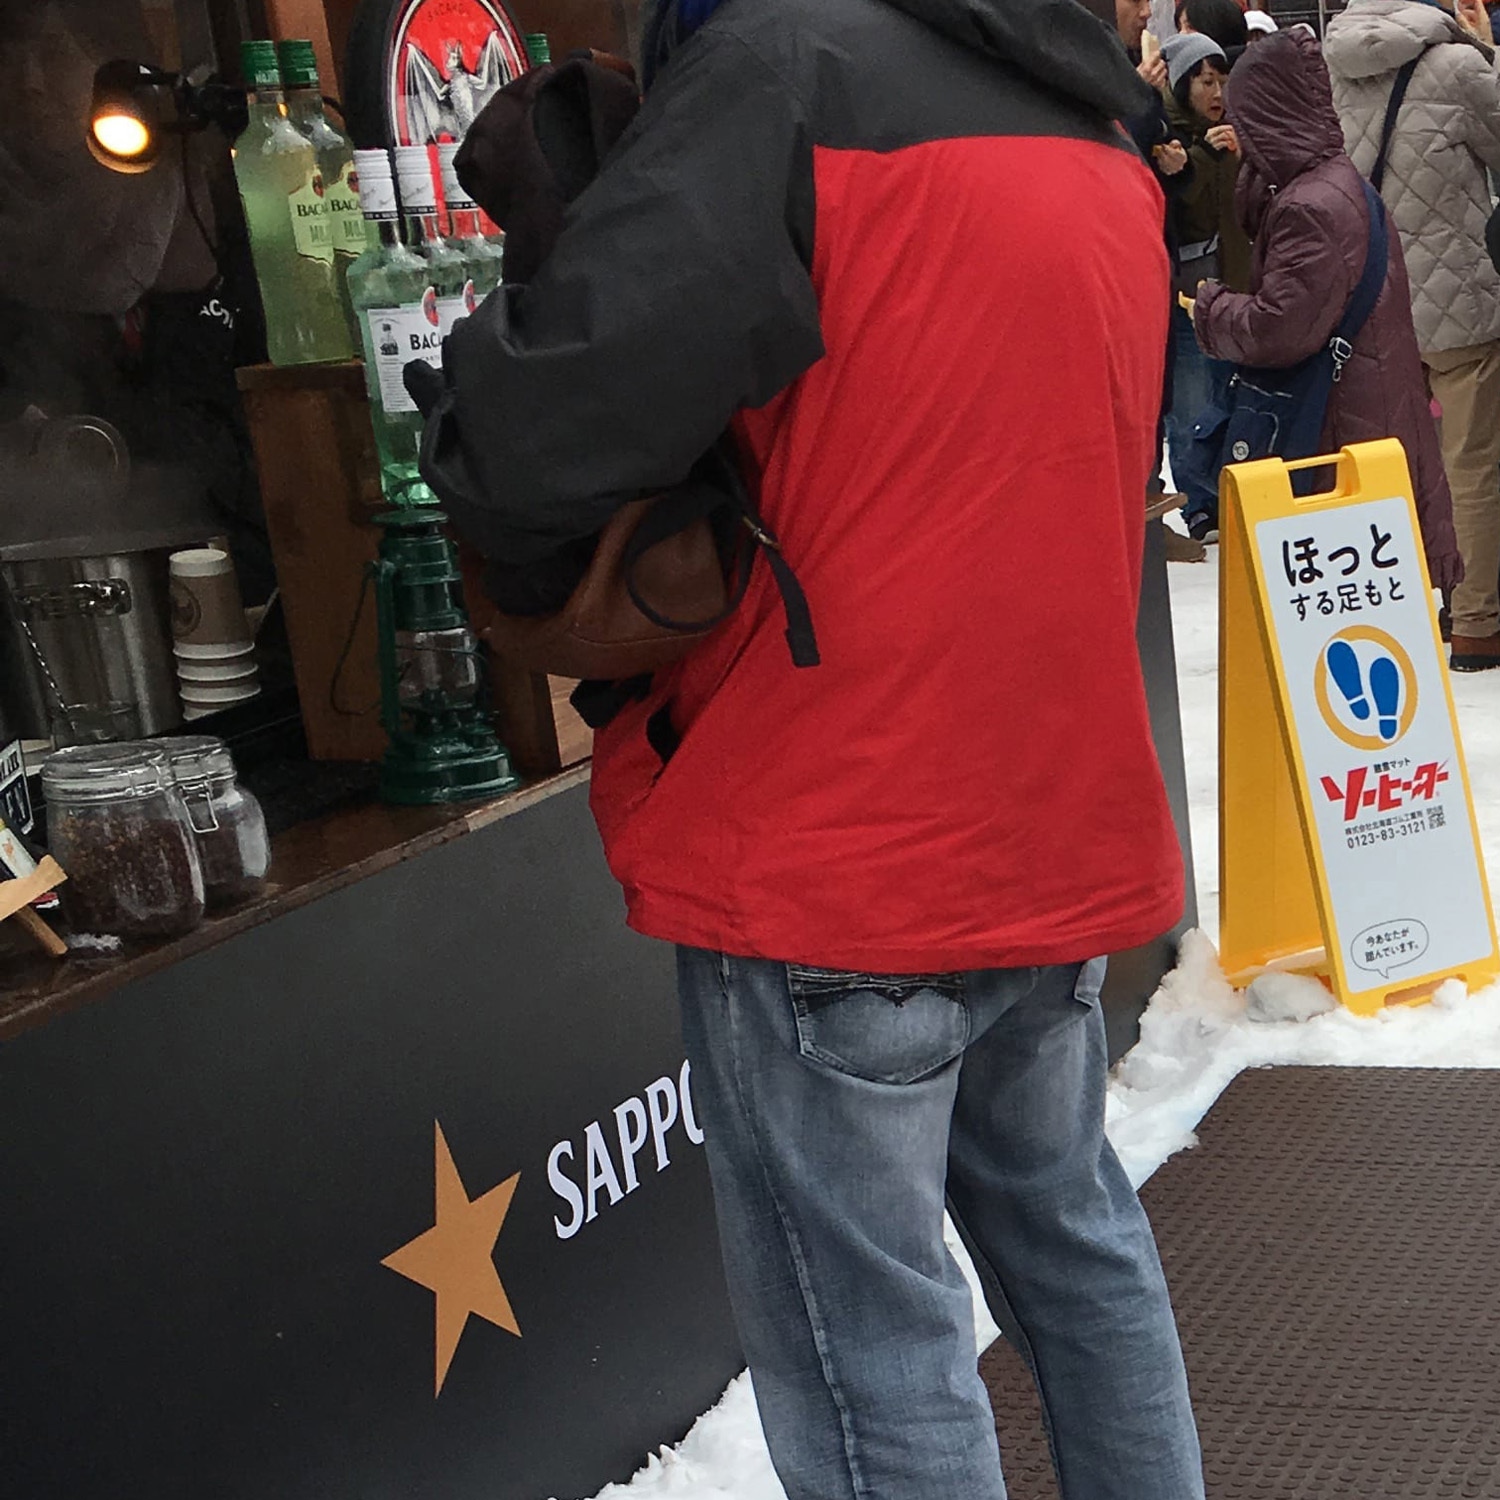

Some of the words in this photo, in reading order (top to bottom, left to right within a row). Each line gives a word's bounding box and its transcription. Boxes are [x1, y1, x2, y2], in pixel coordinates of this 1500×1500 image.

[1282, 523, 1399, 587] ほっと
[1290, 577, 1405, 621] する足もと
[1347, 820, 1426, 849] 0123-83-3121
[1365, 927, 1410, 947] 今あなたが
